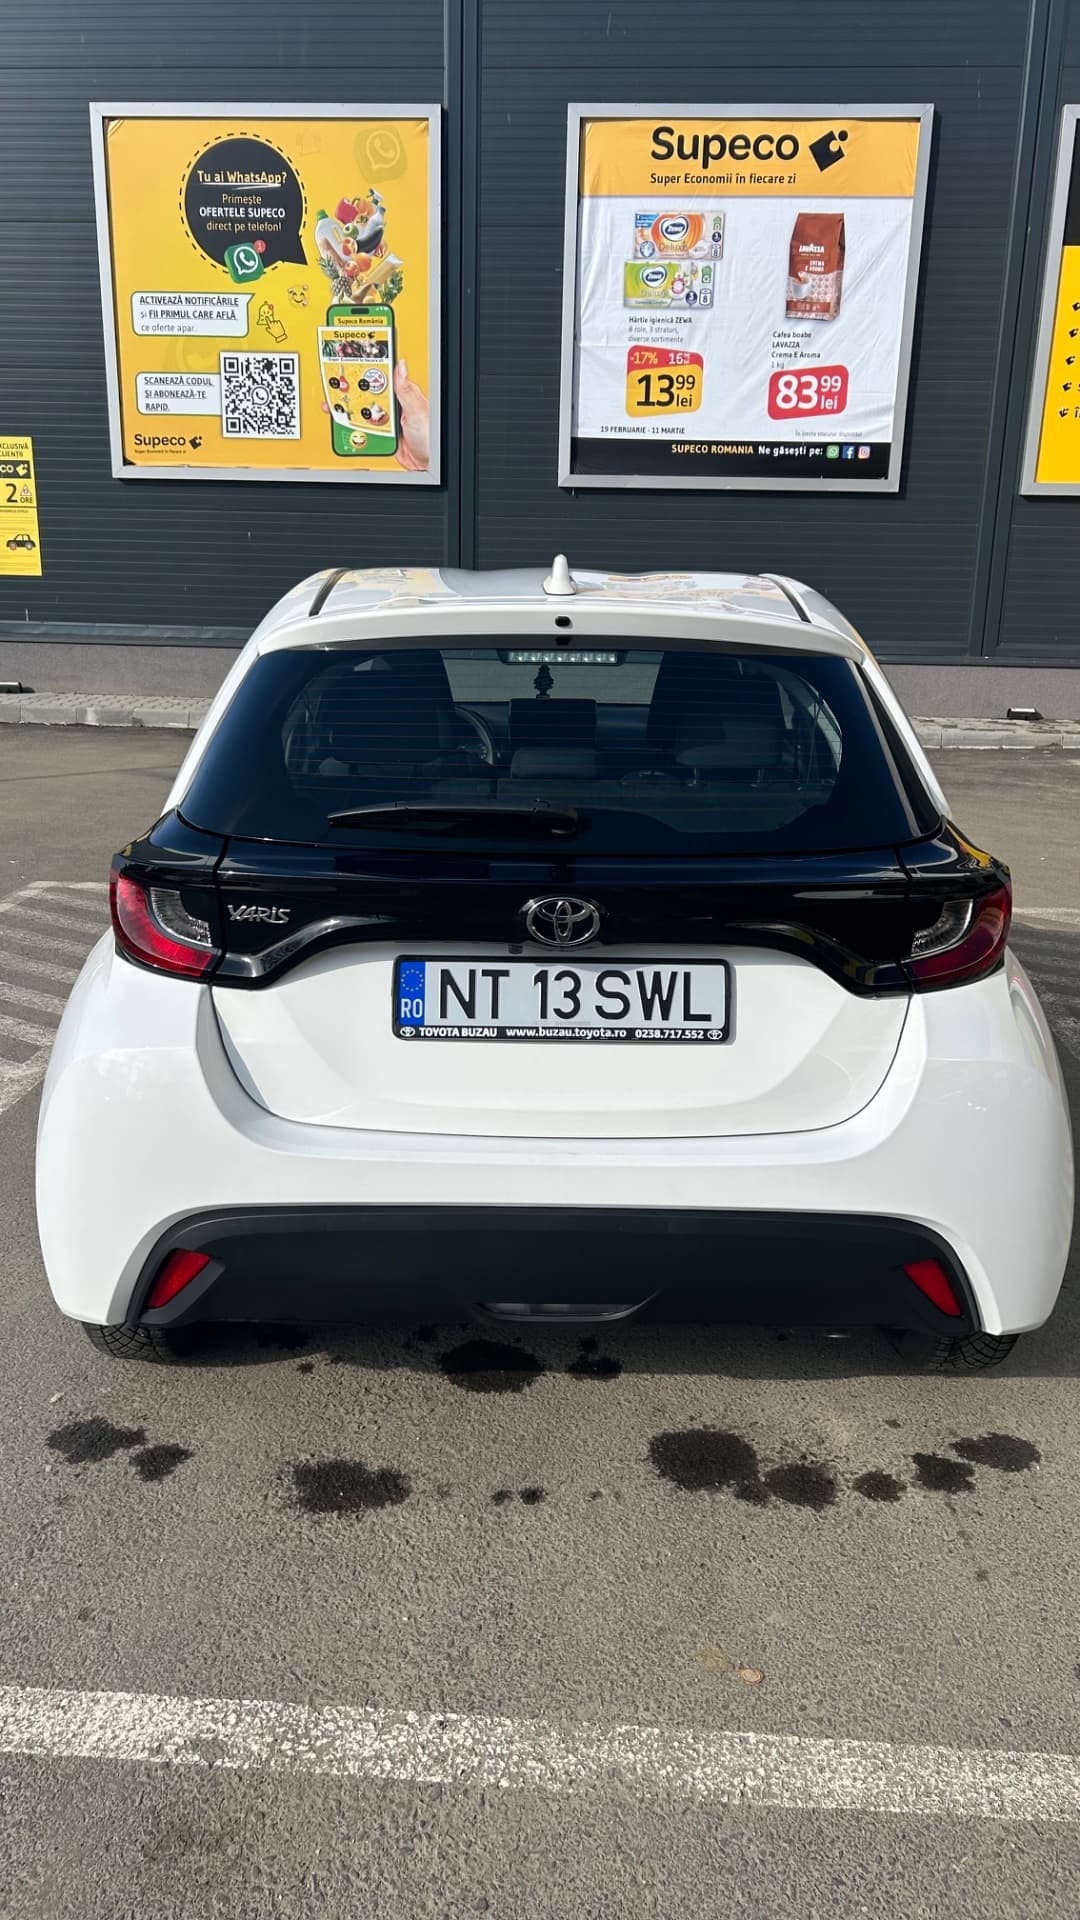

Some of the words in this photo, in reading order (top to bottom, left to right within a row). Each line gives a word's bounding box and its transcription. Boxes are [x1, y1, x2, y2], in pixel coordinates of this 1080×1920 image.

[650, 126, 800, 170] Supeco
[197, 170, 211, 182] Tu
[214, 170, 224, 182] ai
[226, 170, 287, 185] WhatsApp?
[650, 172, 681, 187] Super
[684, 172, 732, 184] Economii
[735, 172, 746, 184] în
[750, 172, 785, 184] fiecare
[787, 173, 796, 184] zi
[222, 193, 262, 205] Primește
[199, 206, 246, 218] OFERTELE
[248, 207, 286, 218] SUPECO
[206, 221, 232, 231] direct
[234, 222, 246, 234] pe
[248, 221, 282, 232] telefon!
[140, 295, 183, 305] ACTIVEAZĂ
[184, 296, 239, 306] NOTIFICĂRILE
[149, 310, 158, 318] FII
[160, 310, 190, 319] PRIMUL
[192, 310, 214, 319] CARE
[216, 310, 236, 319] AFLĂ
[675, 316, 693, 324] ZEWA
[151, 323, 175, 332] oferte
[333, 331, 367, 340] Supeco
[792, 331, 812, 339] boabe
[630, 351, 658, 365] -17%
[144, 376, 184, 385] SCANEAZĂ
[185, 377, 213, 386] CODUL
[153, 390, 207, 399] ABONEAZĂ-TE
[637, 374, 674, 407] 13
[676, 393, 693, 407] lei
[776, 374, 819, 410] 83
[820, 395, 838, 410] lei
[600, 425, 609, 433] 19
[661, 426, 685, 434] MARTIE
[134, 433, 186, 448] Supeco
[671, 444, 708, 454] SUPECO
[711, 444, 754, 454] ROMANIA
[758, 445, 770, 455] Ne
[773, 445, 807, 457] găsești
[809, 446, 824, 457] pe:
[6, 483, 18, 503] 2
[20, 496, 33, 504] ORE
[439, 968, 510, 1019] NT
[533, 969, 582, 1020] 13
[595, 970, 712, 1022] SWL
[401, 998, 423, 1018] RO
[418, 1027, 460, 1038] TOYOTA
[461, 1027, 498, 1038] BUZAU
[506, 1026, 627, 1040] www.buzau.toyota.ro
[635, 1028, 704, 1039] 0238.717.552
